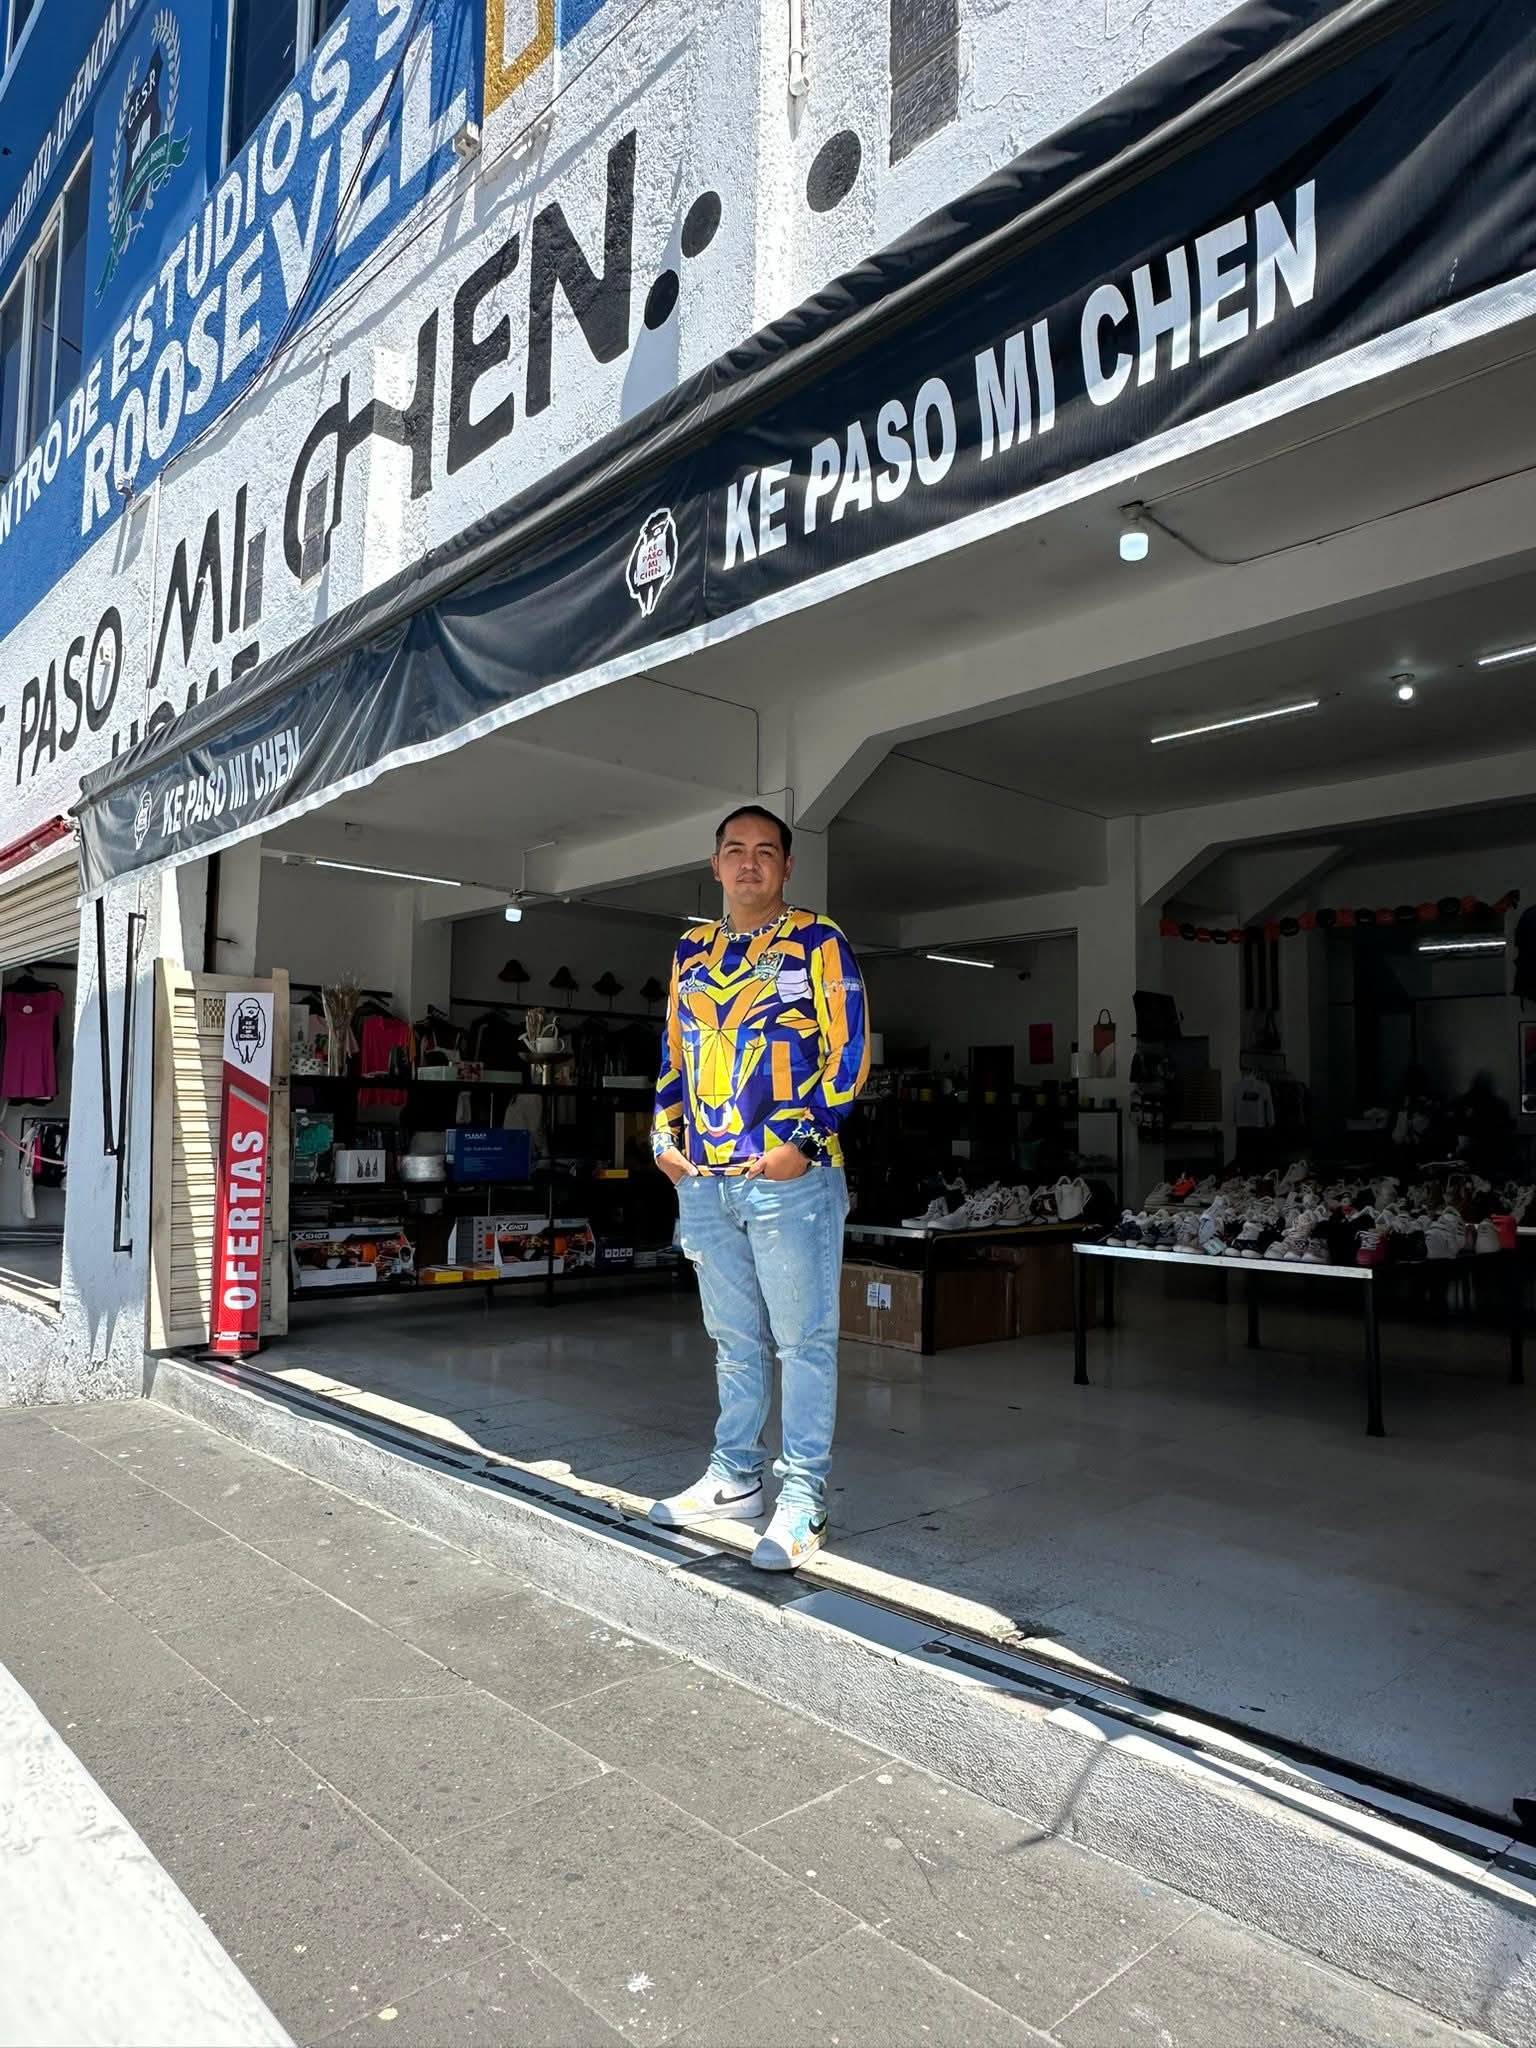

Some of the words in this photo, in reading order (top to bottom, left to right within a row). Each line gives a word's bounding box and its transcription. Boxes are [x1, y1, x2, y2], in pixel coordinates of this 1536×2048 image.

[67, 357, 102, 459] DE
[111, 16, 350, 400] ESTUDIOS
[723, 459, 792, 571] KE
[804, 377, 957, 535] PASO
[975, 318, 1055, 462] MI
[1080, 179, 1316, 407] CHEN
[16, 605, 123, 786] PASO
[149, 481, 248, 689] MI
[161, 784, 184, 838] KE
[184, 765, 227, 828] PASO
[228, 752, 248, 811] MI
[252, 725, 300, 801] CHEN
[224, 1131, 264, 1311] OFERTAS
